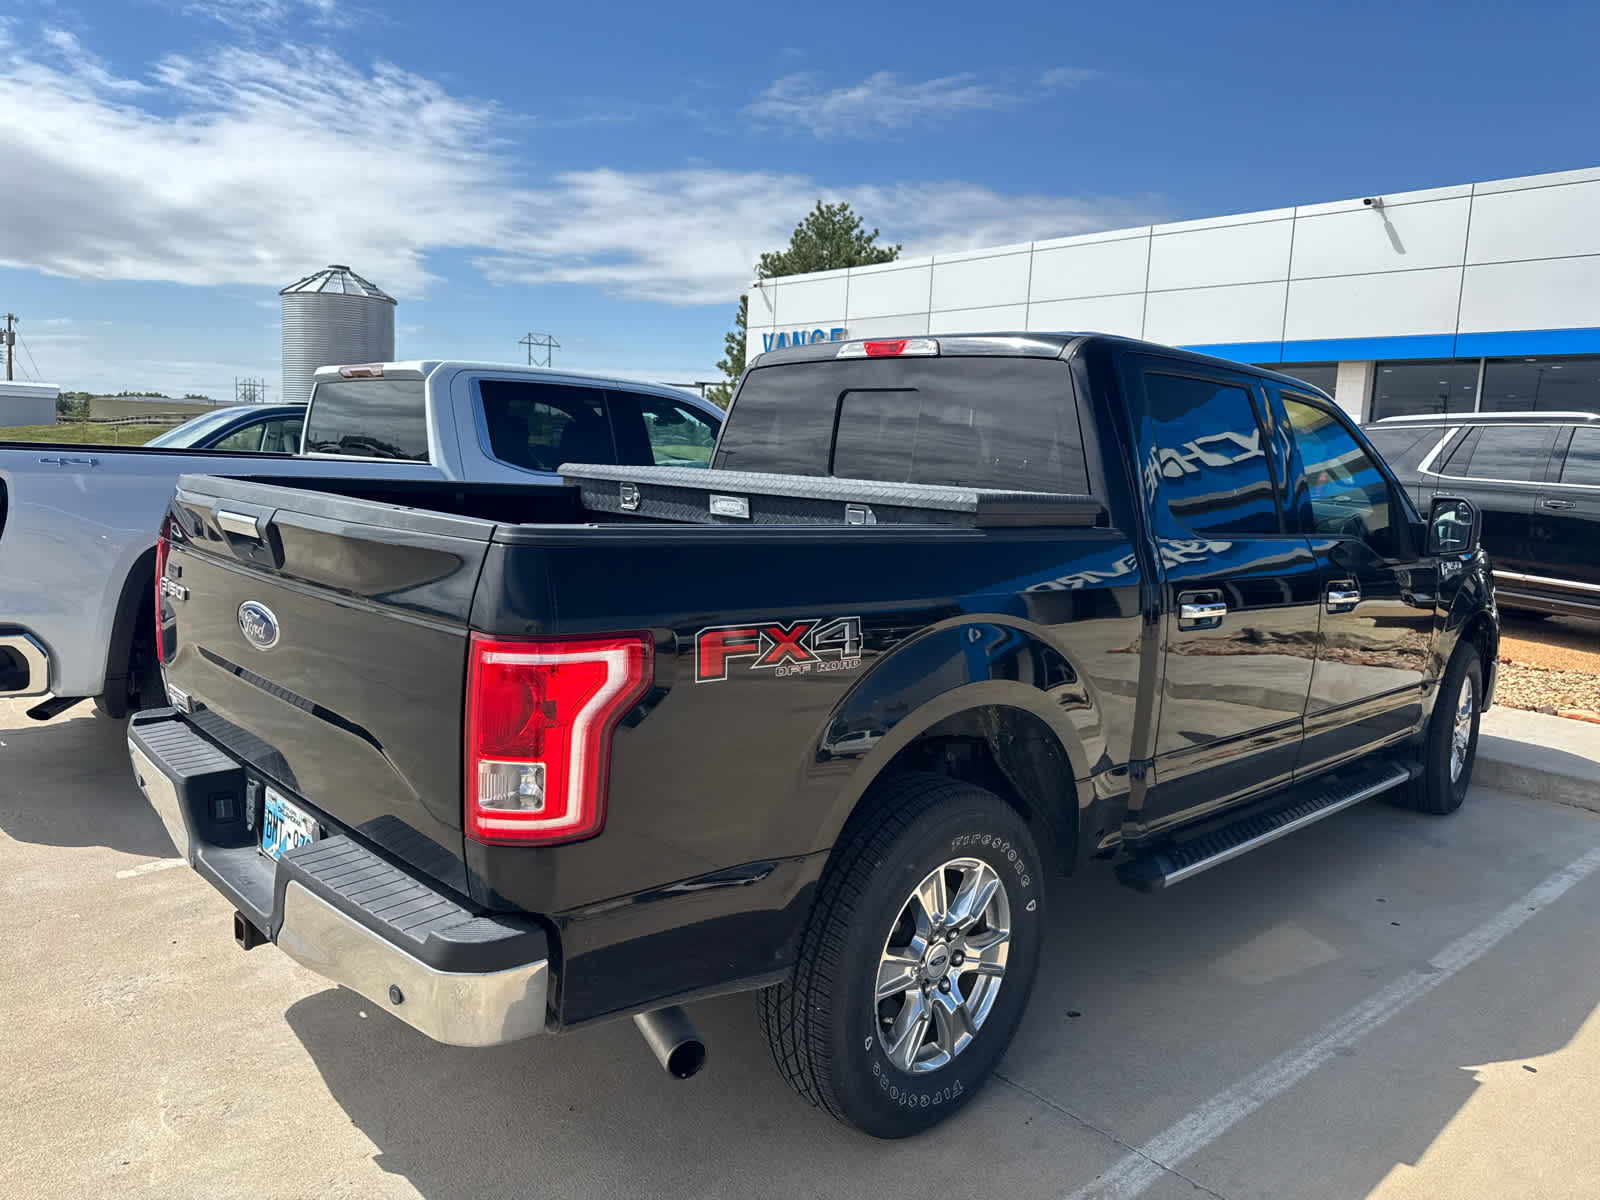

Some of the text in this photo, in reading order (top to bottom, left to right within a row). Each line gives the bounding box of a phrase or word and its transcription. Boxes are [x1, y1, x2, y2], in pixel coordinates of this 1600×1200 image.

[695, 616, 863, 683] FX4
[775, 658, 862, 677] OFF ROAD
